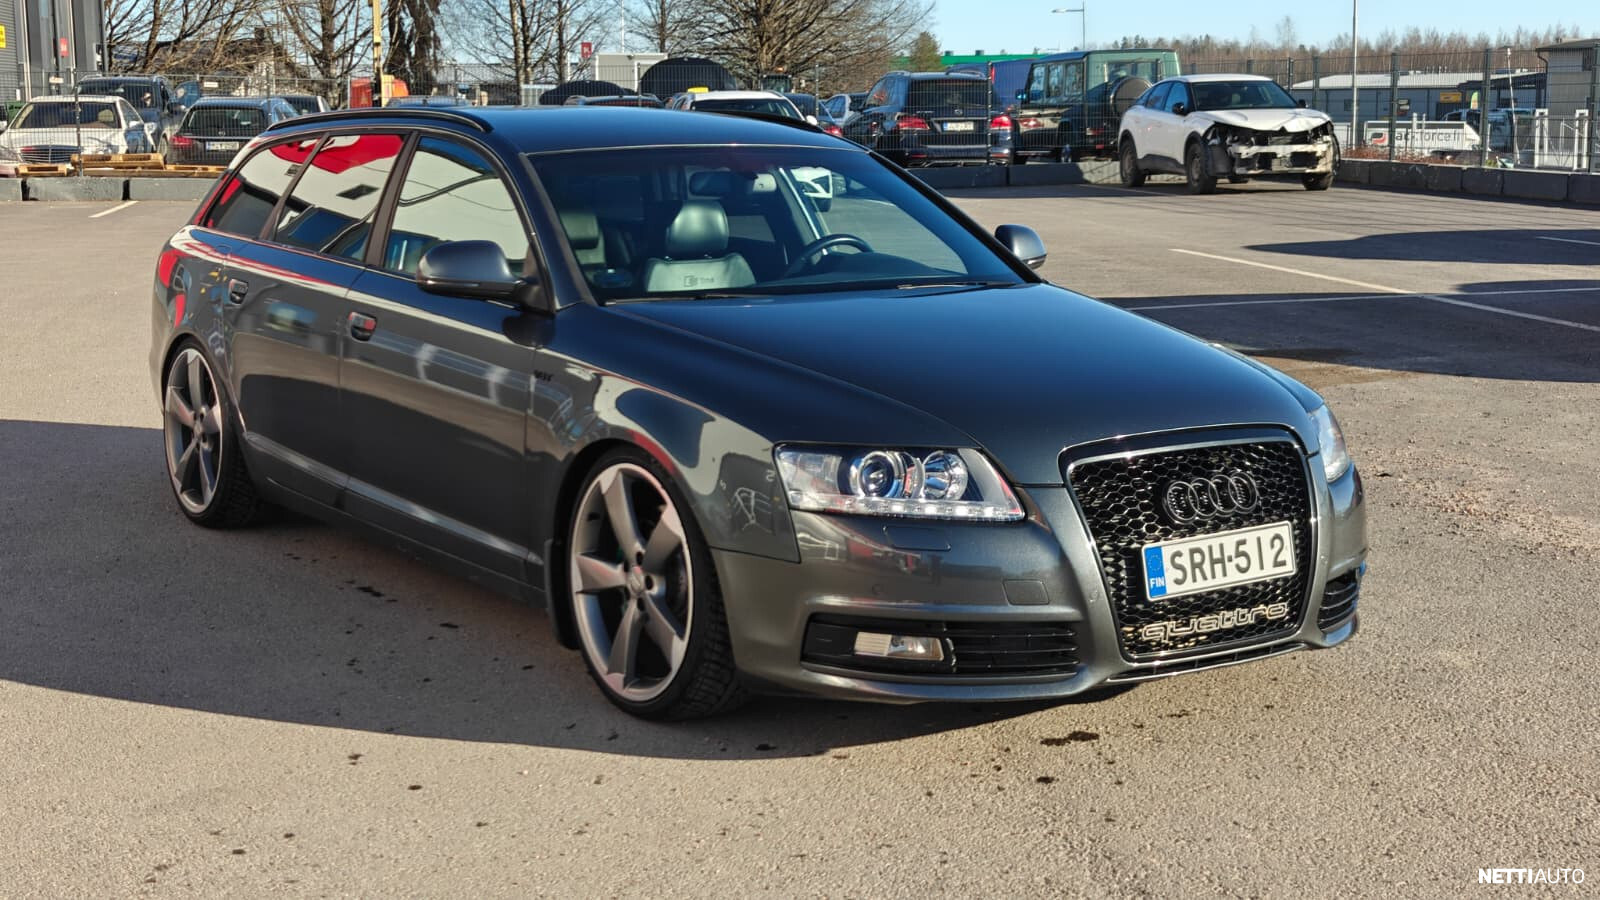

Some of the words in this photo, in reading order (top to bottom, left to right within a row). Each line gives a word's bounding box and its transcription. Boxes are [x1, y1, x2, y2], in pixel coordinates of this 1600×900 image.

[1170, 533, 1287, 585] SRH-512
[1150, 577, 1165, 589] FIN
[1142, 602, 1288, 643] quattro
